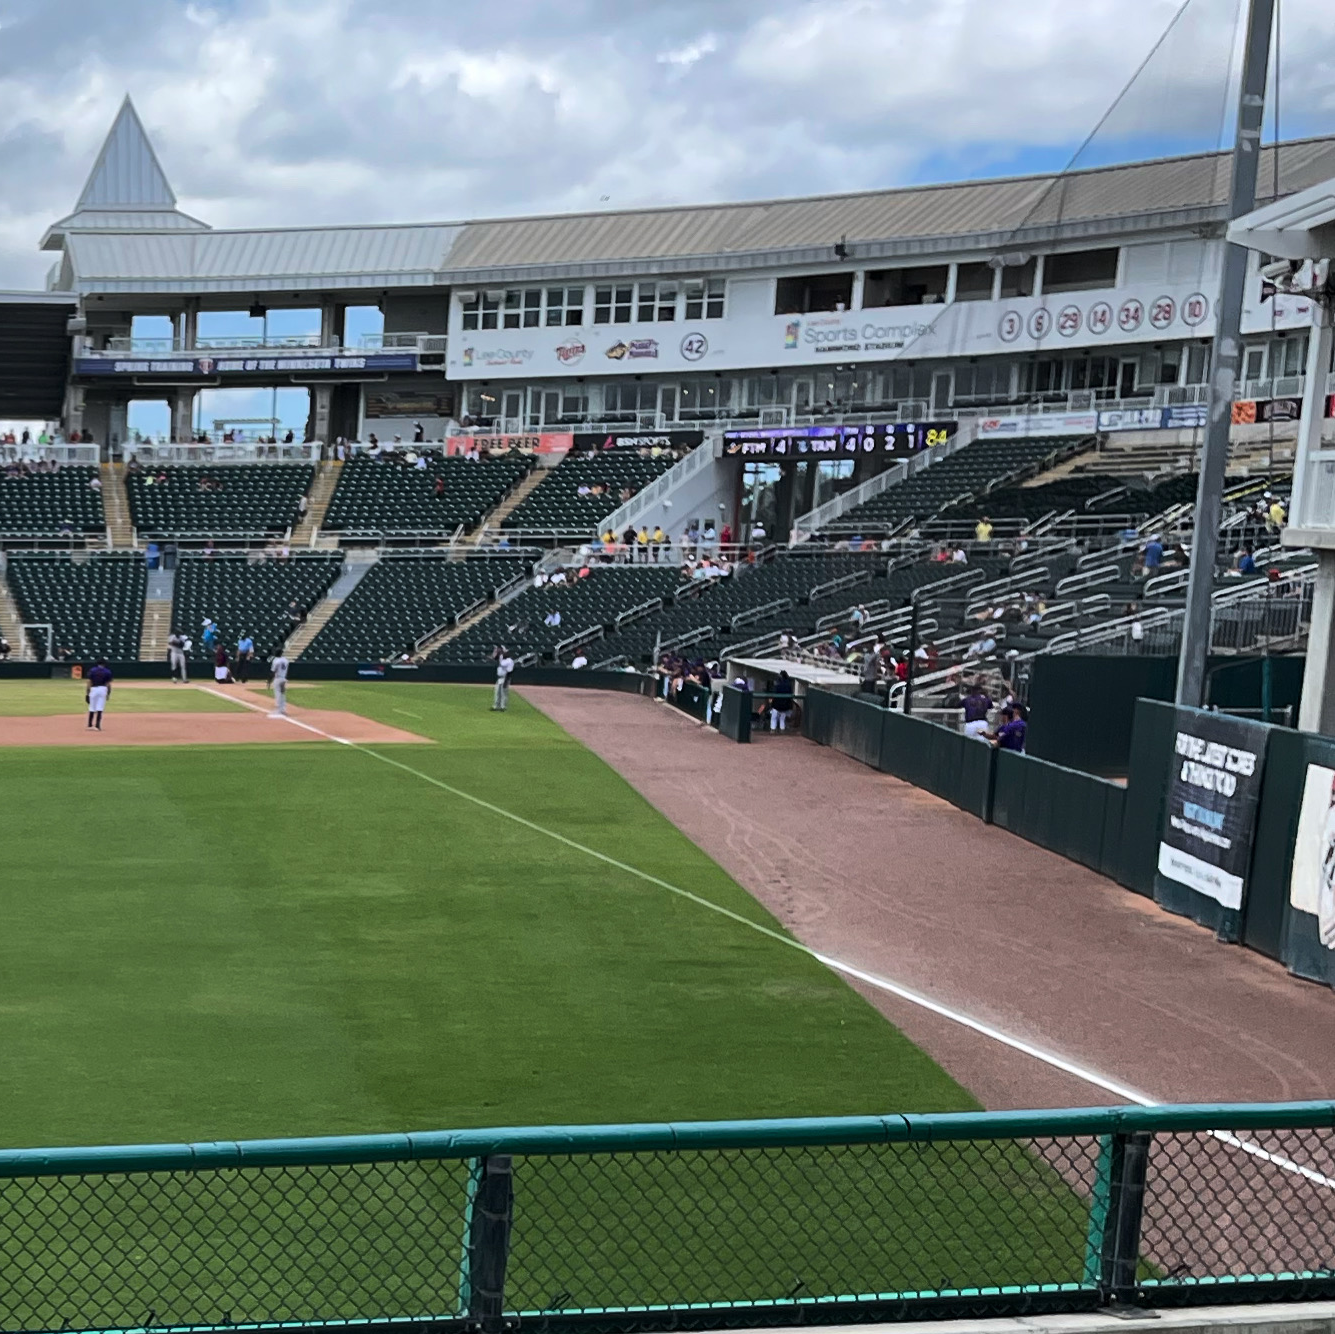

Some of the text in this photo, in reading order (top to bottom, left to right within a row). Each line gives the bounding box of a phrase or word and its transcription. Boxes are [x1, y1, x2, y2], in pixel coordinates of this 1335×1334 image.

[804, 321, 937, 345] Sports Complex
[1006, 318, 1015, 335] 3
[684, 340, 704, 354] 42
[473, 436, 540, 450] FREE BEER
[863, 437, 874, 452] 0
[884, 436, 895, 451] 2
[926, 428, 947, 447] 84
